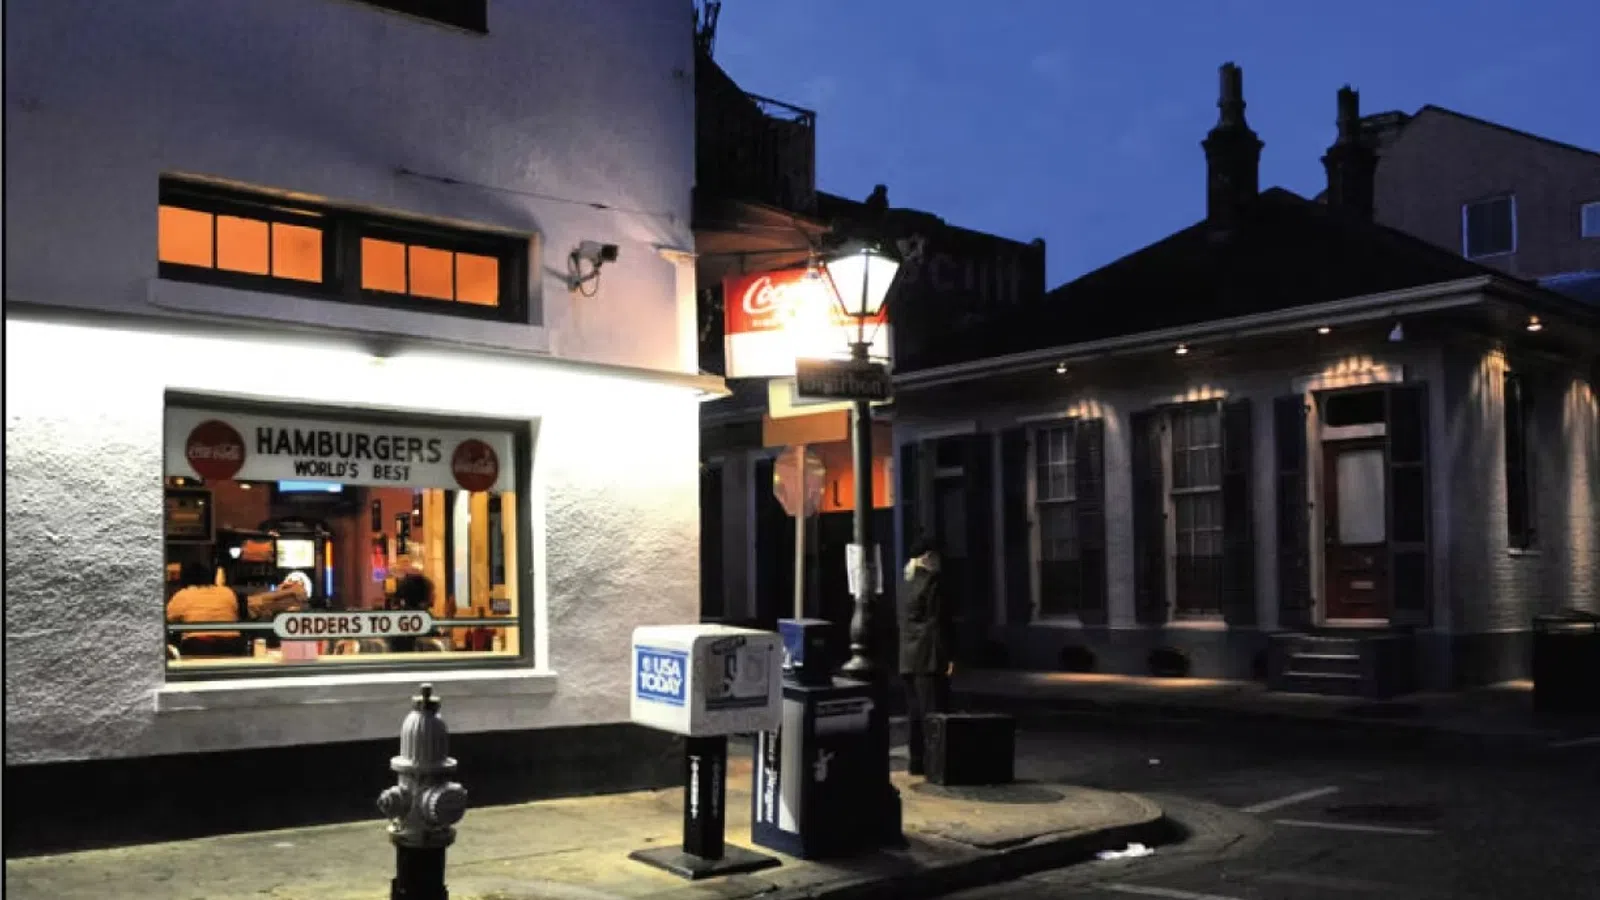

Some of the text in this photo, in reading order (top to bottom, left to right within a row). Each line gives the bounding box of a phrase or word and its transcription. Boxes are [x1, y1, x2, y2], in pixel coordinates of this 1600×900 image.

[256, 427, 442, 463] HAMBURGERS
[294, 460, 411, 481] WORLD'S BEST
[285, 615, 423, 634] ORDERS TO GO
[653, 656, 680, 678] USA
[640, 670, 683, 696] TODAY
